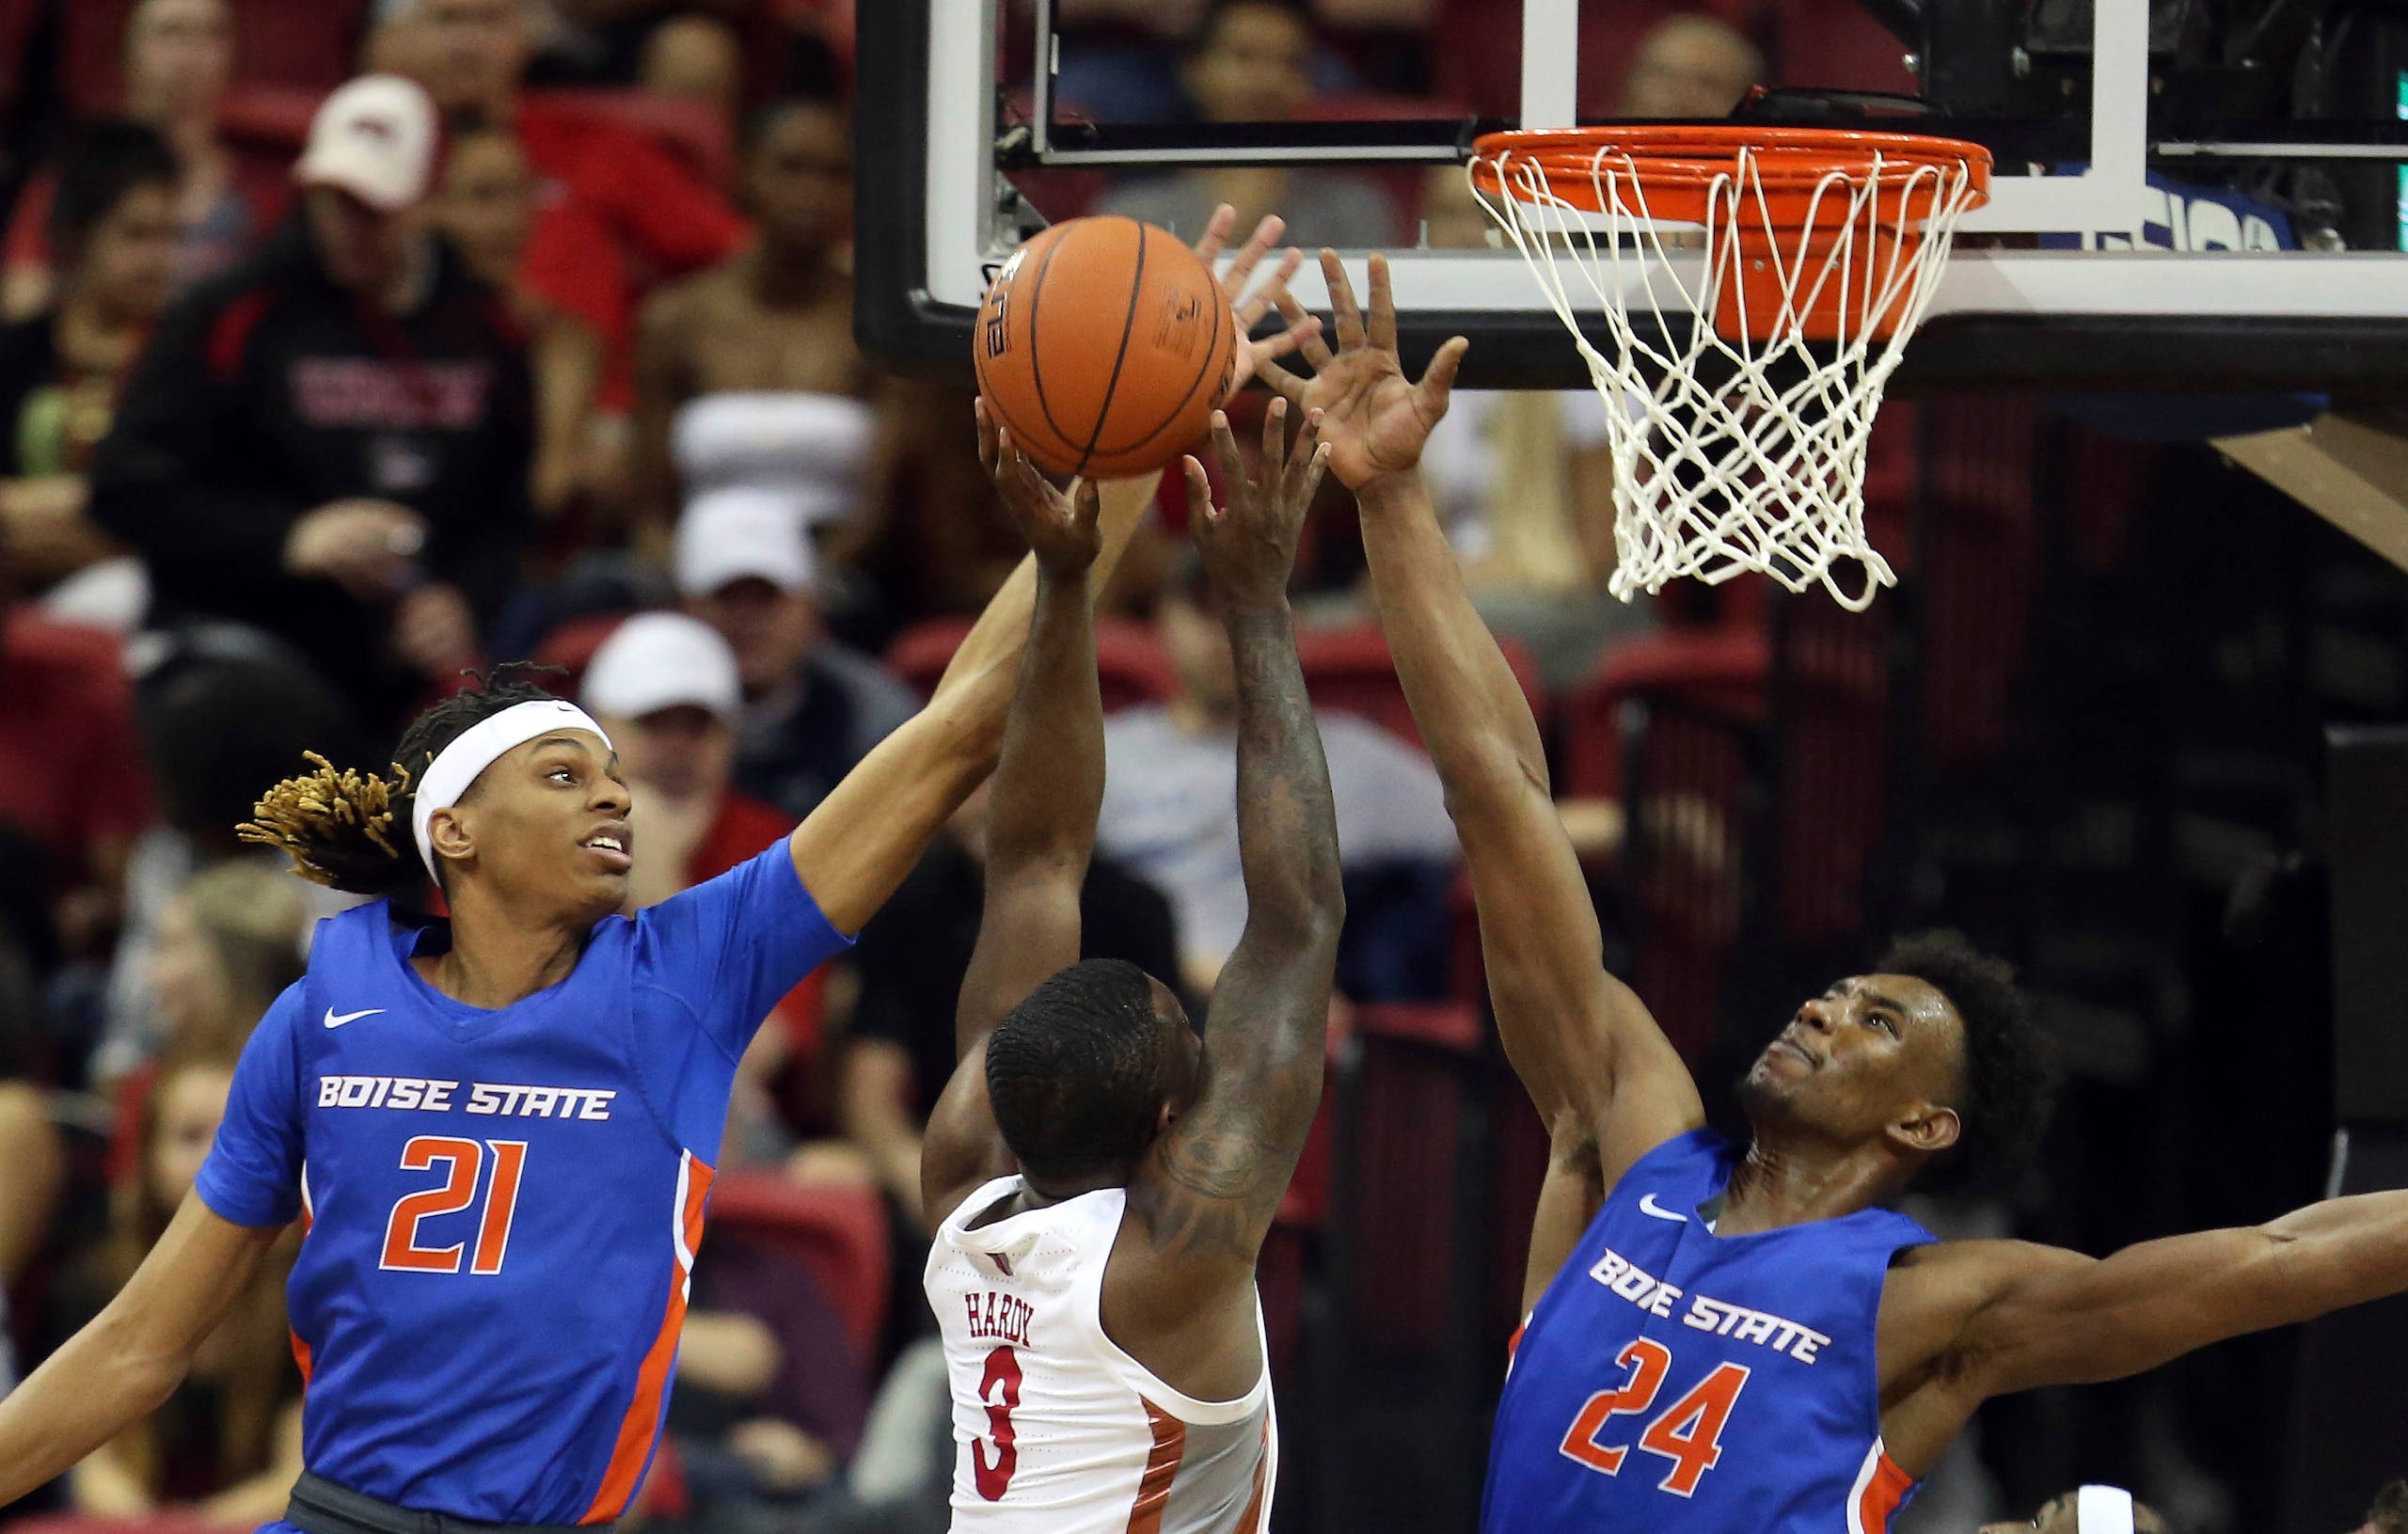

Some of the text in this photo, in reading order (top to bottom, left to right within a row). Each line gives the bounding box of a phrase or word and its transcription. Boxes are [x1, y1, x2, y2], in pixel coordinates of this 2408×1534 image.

[318, 1075, 617, 1121] BOISE STATE
[378, 1134, 529, 1274] 21
[965, 1291, 1034, 1348] HARDY
[1589, 1247, 1831, 1365] BOIE STATE
[972, 1345, 1022, 1502] 3
[1559, 1336, 1751, 1498] 24
